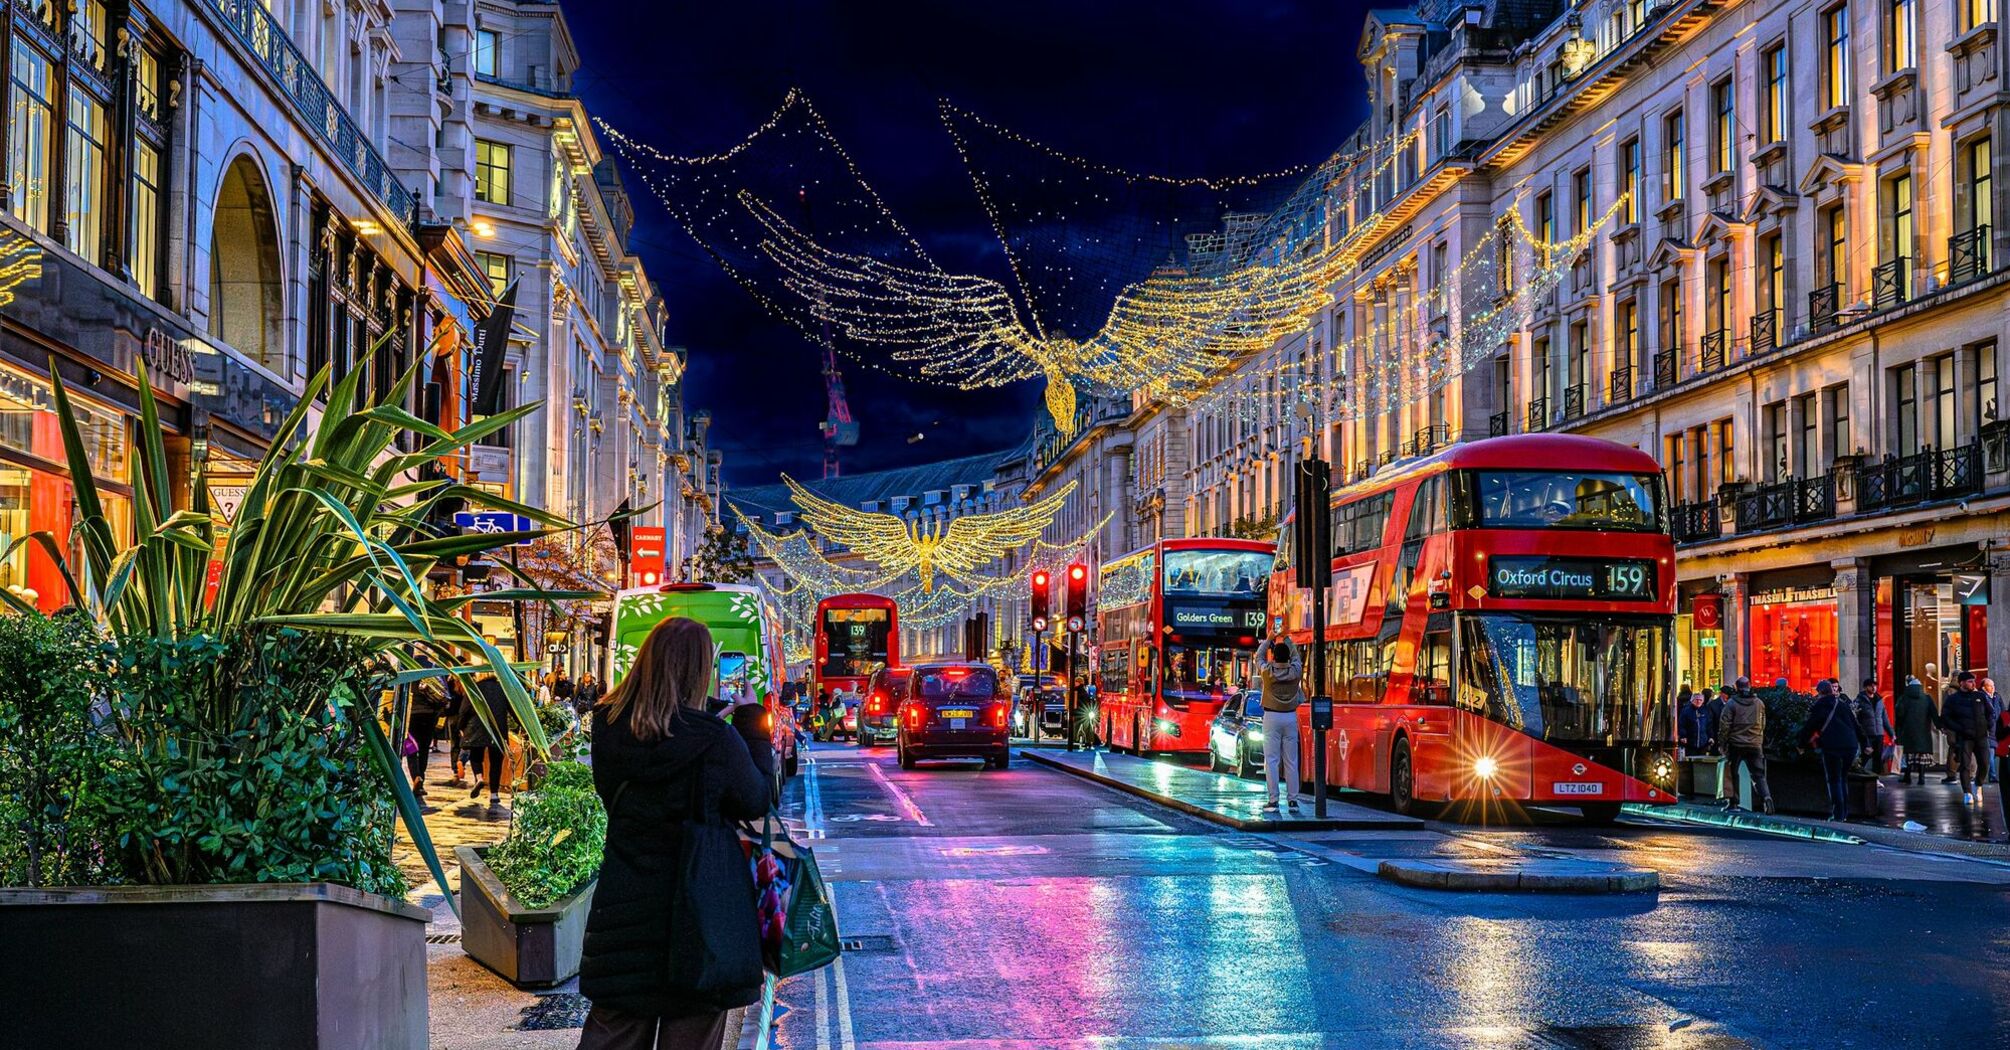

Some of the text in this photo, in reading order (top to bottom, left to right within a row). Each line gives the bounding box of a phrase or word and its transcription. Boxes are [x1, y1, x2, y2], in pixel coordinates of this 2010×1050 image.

[147, 327, 198, 384] GUESS
[471, 328, 488, 403] Massimo Dutti
[213, 487, 246, 497] GUESS
[1497, 566, 1643, 593] Oxford Circus 159
[1176, 611, 1266, 627] Golders Green 139
[850, 625, 865, 636] 139
